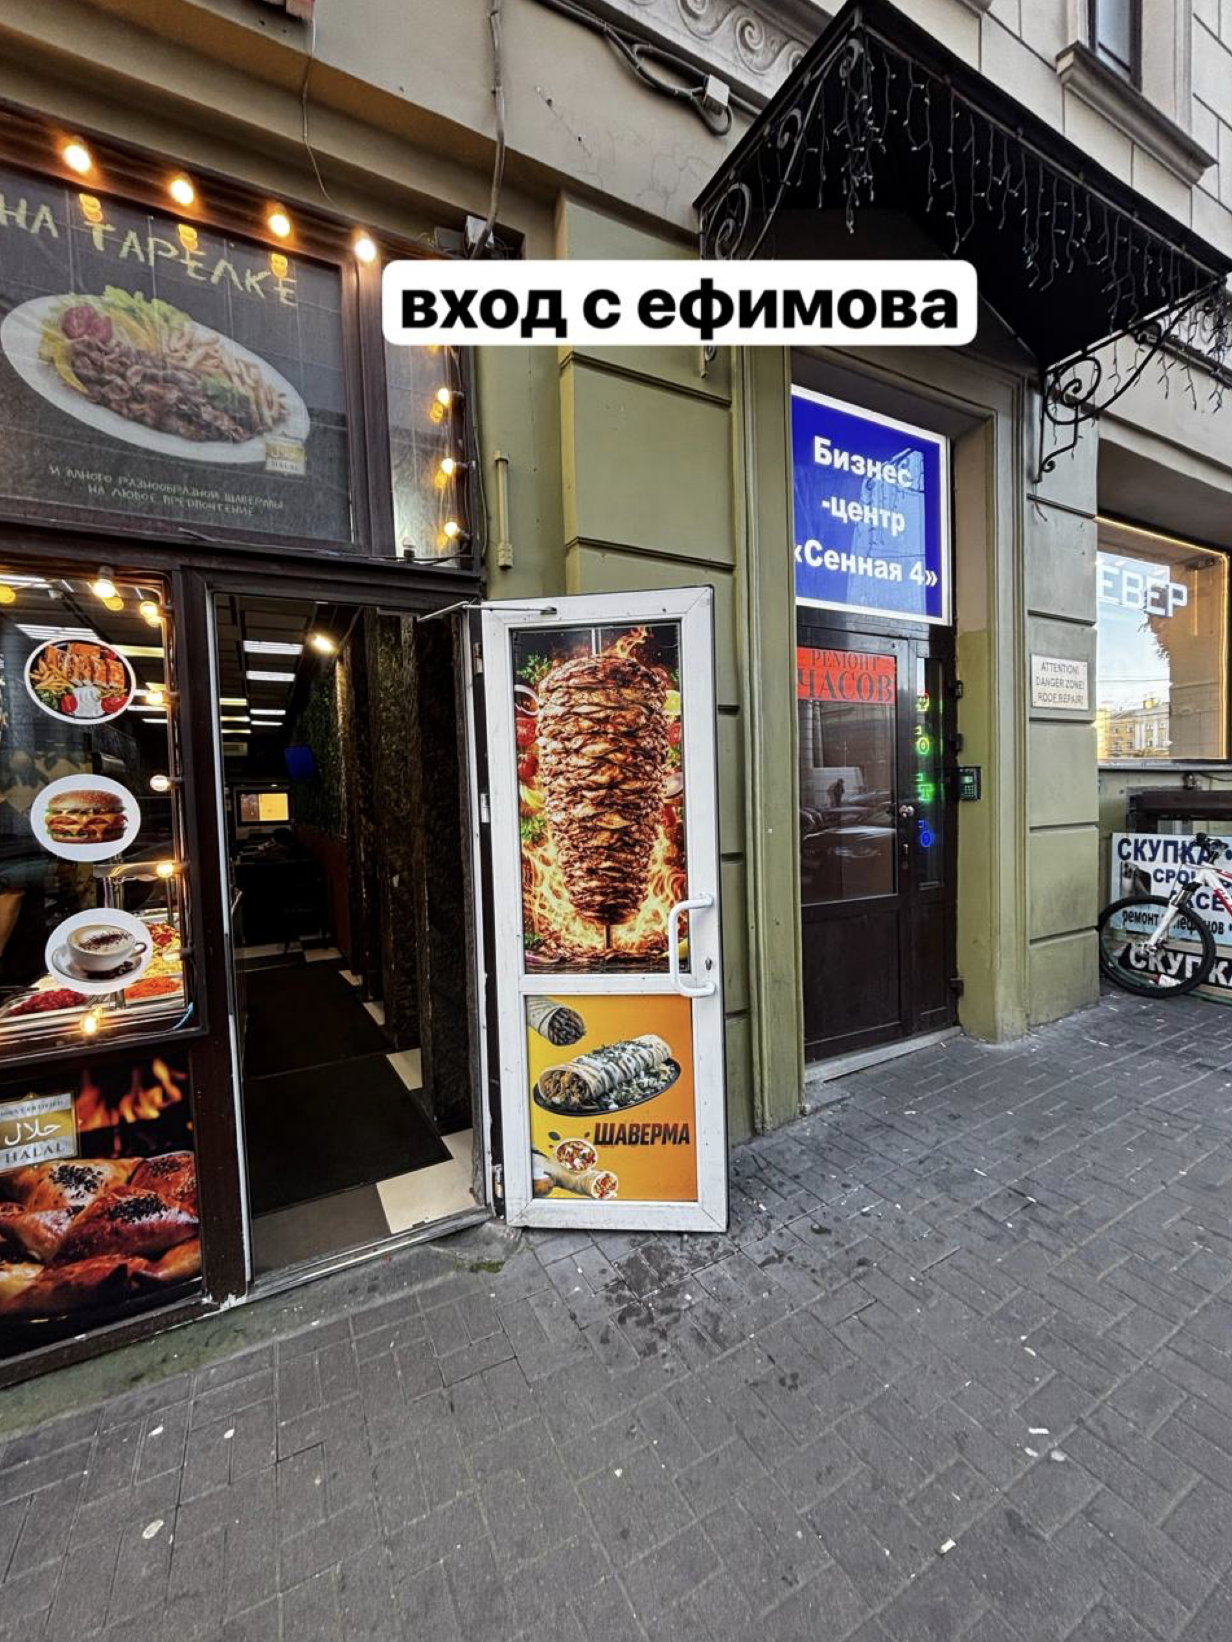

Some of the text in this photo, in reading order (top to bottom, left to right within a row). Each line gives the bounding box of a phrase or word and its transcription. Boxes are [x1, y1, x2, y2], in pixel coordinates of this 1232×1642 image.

[0, 193, 299, 306] НА ТАРЕЛКЕ
[813, 435, 912, 488] Бизнес
[909, 560, 938, 587] 4»
[811, 649, 881, 672] РЕМОНТ
[797, 667, 893, 702] ЧАСОВ
[1121, 909, 1160, 926] ремонт
[1129, 946, 1232, 987] СКУПК
[4, 1118, 62, 1146] حلال
[593, 1122, 690, 1146] ШАВЕРМА
[5, 1142, 66, 1164] HALAL
